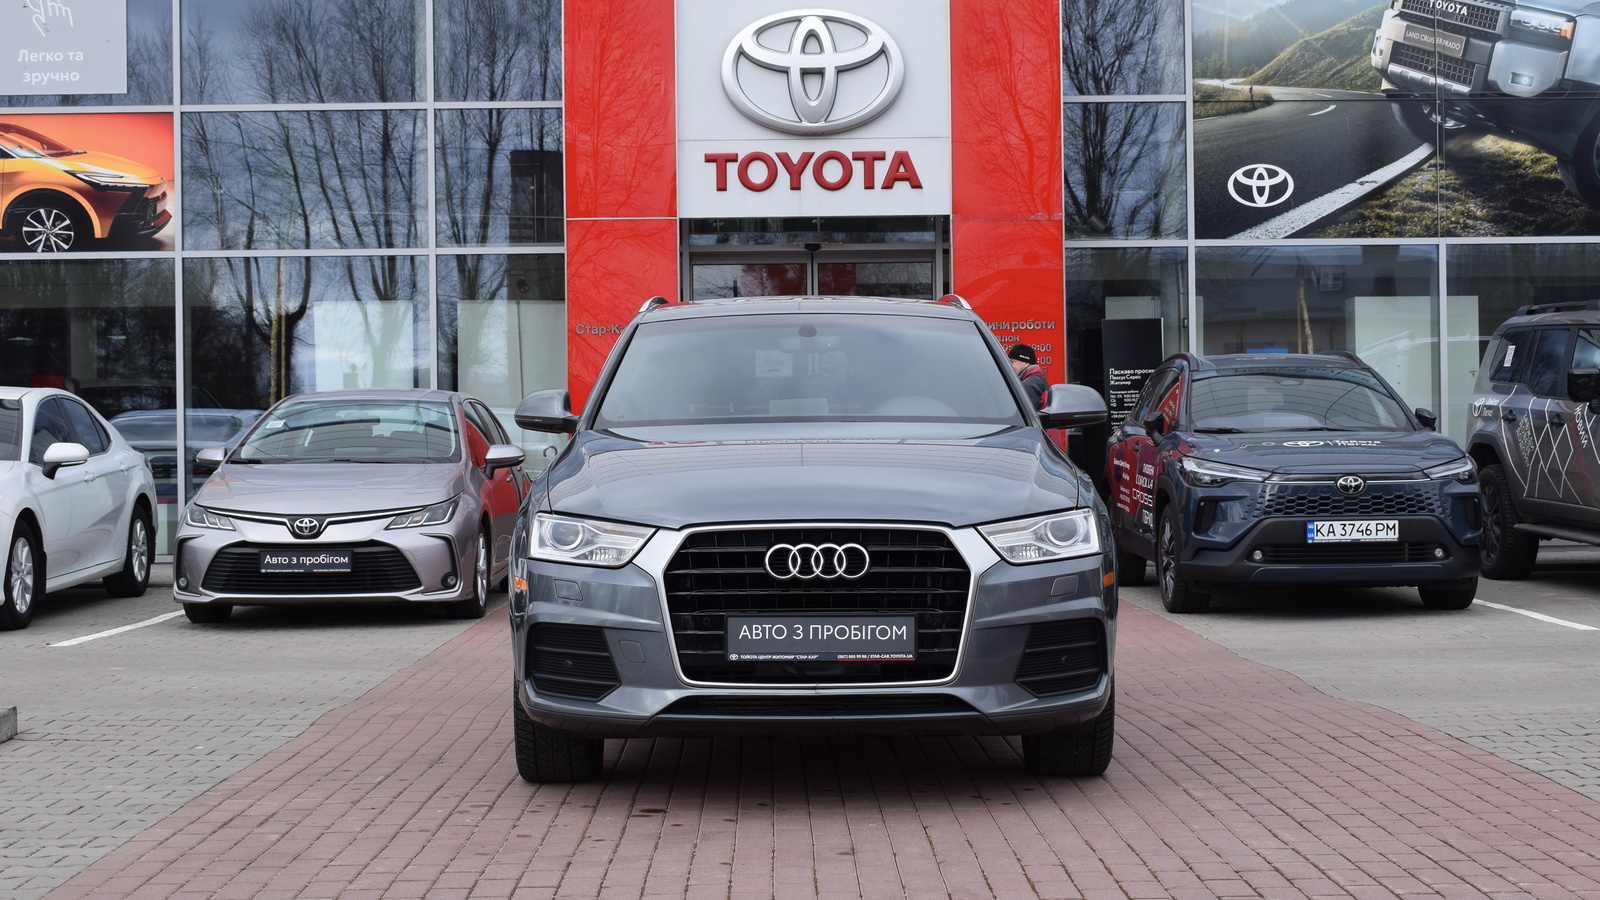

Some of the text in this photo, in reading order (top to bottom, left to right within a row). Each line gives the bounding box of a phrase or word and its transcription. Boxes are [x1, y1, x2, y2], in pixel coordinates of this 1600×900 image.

[1430, 0, 1468, 15] TOYOTA
[1406, 30, 1461, 50] LAND CRUISER PRADO
[18, 49, 84, 62] Легко та
[22, 71, 80, 85] зручно
[704, 149, 924, 193] TOYOTA
[1012, 318, 1055, 332] роботи
[1574, 404, 1588, 448] НОВИЙ
[1136, 474, 1154, 490] COROLLA
[1132, 488, 1153, 507] CROSS
[1316, 522, 1396, 538] KA 3746 PM
[264, 554, 288, 564] Авто
[300, 554, 348, 566] пробігом
[739, 624, 907, 640] АВТО З ПРОБІГОМ
